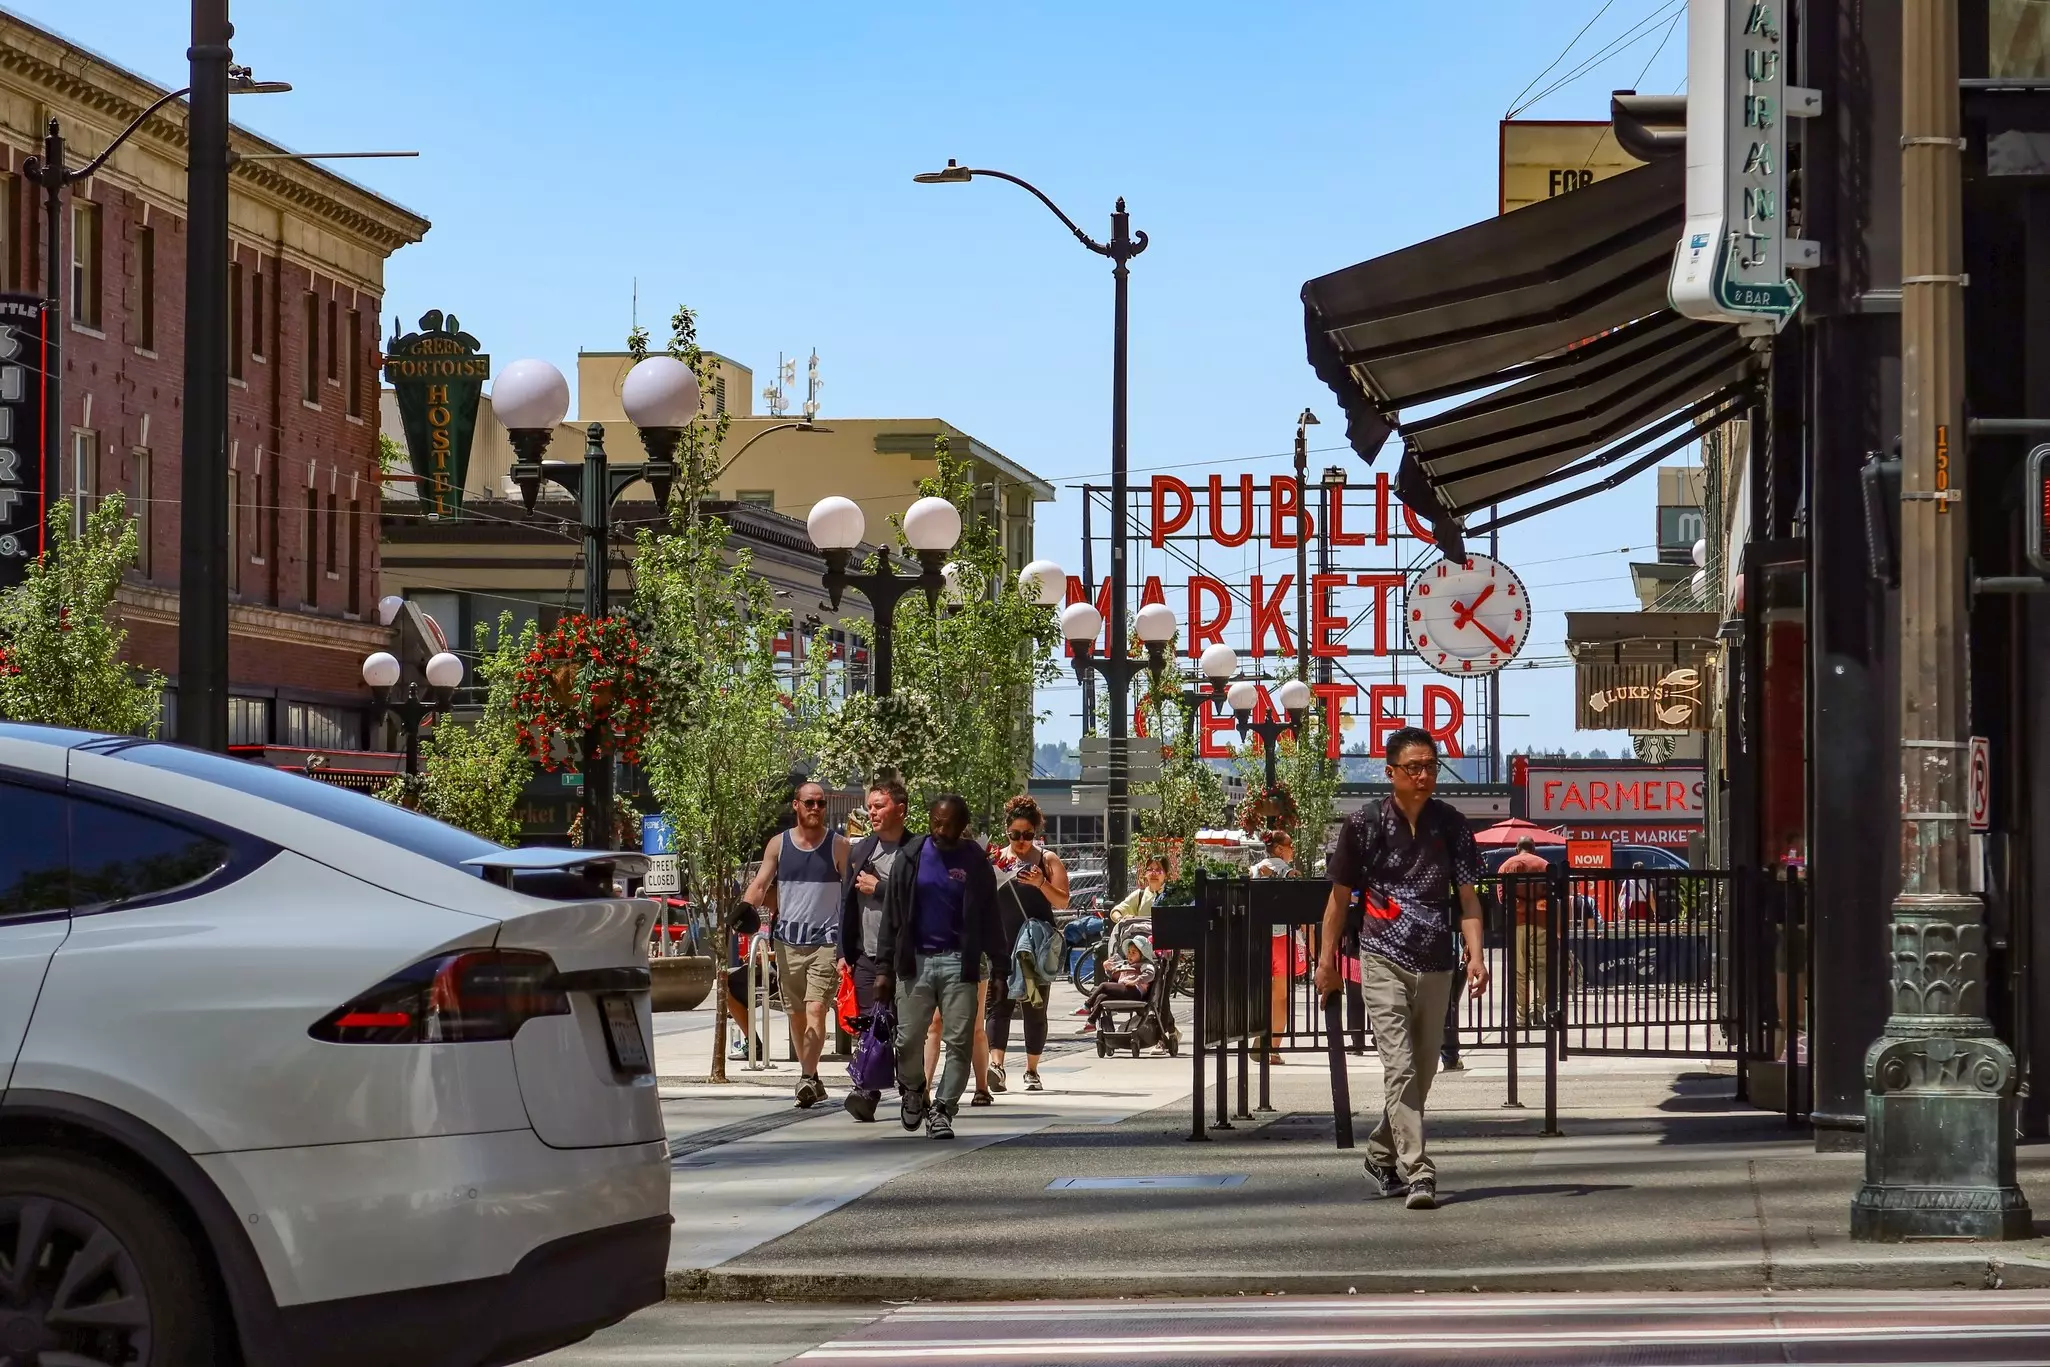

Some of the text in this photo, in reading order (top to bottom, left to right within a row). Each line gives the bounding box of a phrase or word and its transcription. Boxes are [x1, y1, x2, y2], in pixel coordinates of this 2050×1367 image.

[1745, 291, 1770, 305] BAR
[411, 338, 464, 356] GREEN
[389, 360, 487, 376] TORTOISE
[427, 384, 452, 515] HOSTEL
[1937, 426, 1948, 513] 1501
[1462, 559, 1474, 570] 12
[1437, 566, 1447, 577] 11
[1491, 566, 1495, 577] 1
[1418, 584, 1430, 595] 10
[1508, 584, 1516, 595] 2
[1412, 609, 1421, 621] 9
[1514, 609, 1522, 621] 3
[1418, 634, 1428, 647] 8
[1506, 635, 1515, 646] 4
[1437, 653, 1447, 664] 7
[1490, 653, 1498, 664] 5
[1462, 660, 1472, 672] 6
[1605, 686, 1663, 703] LUKE'S
[1544, 781, 1703, 811] FARMERS
[1574, 855, 1604, 865] NOW
[648, 875, 675, 887] CLOSED
